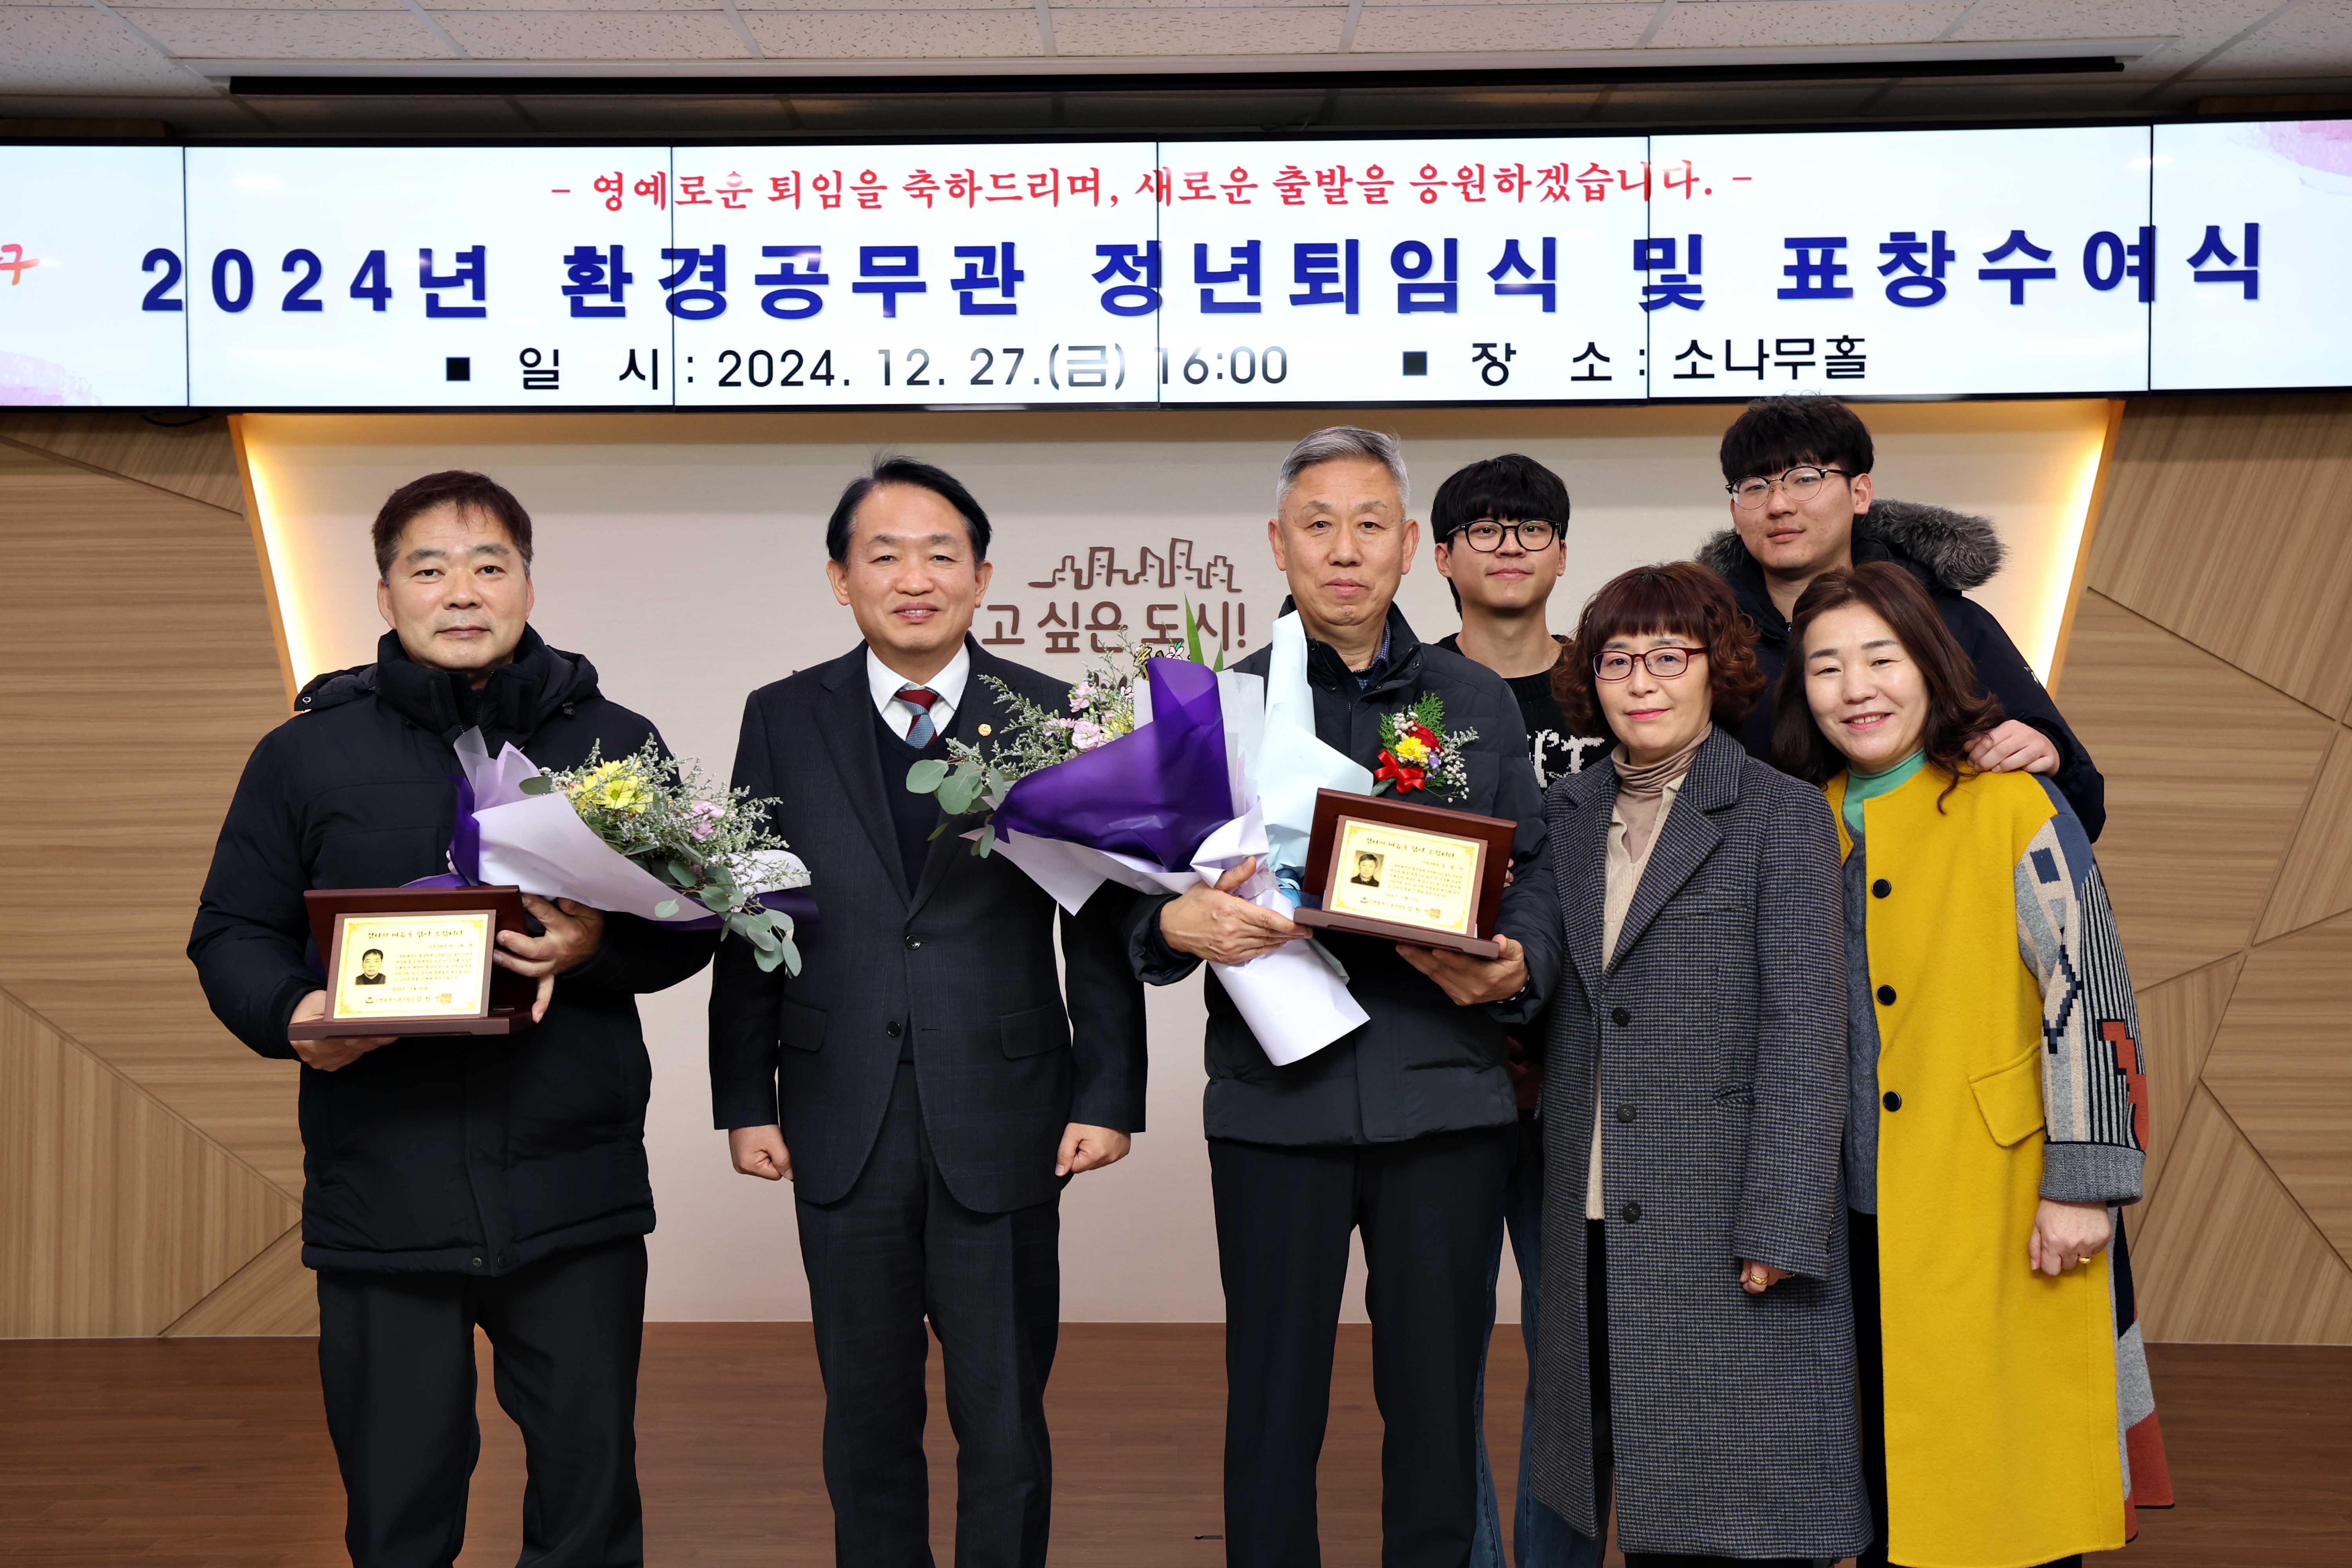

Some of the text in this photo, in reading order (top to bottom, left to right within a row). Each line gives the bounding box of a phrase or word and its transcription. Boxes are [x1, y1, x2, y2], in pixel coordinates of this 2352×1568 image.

[593, 171, 753, 211] 영예로운
[768, 169, 887, 210] 퇴임을
[902, 167, 1118, 209] 축하드리며,
[1134, 166, 1258, 206] 새로운
[1272, 164, 1394, 205] 출발을
[1409, 160, 1713, 204] 응원하겠습니다.
[0, 244, 40, 285] 구
[141, 223, 2261, 321] 2024년 환경공무관 정년퇴임식 및 표창수여식
[718, 349, 850, 388] 2024.
[878, 348, 945, 386] 12.
[970, 343, 1125, 390] 27.(금)
[1154, 346, 1287, 385] 16:00
[1673, 334, 1867, 381] 소나무홀
[1037, 601, 1128, 653] 싶은
[1141, 601, 1246, 652] 도시!
